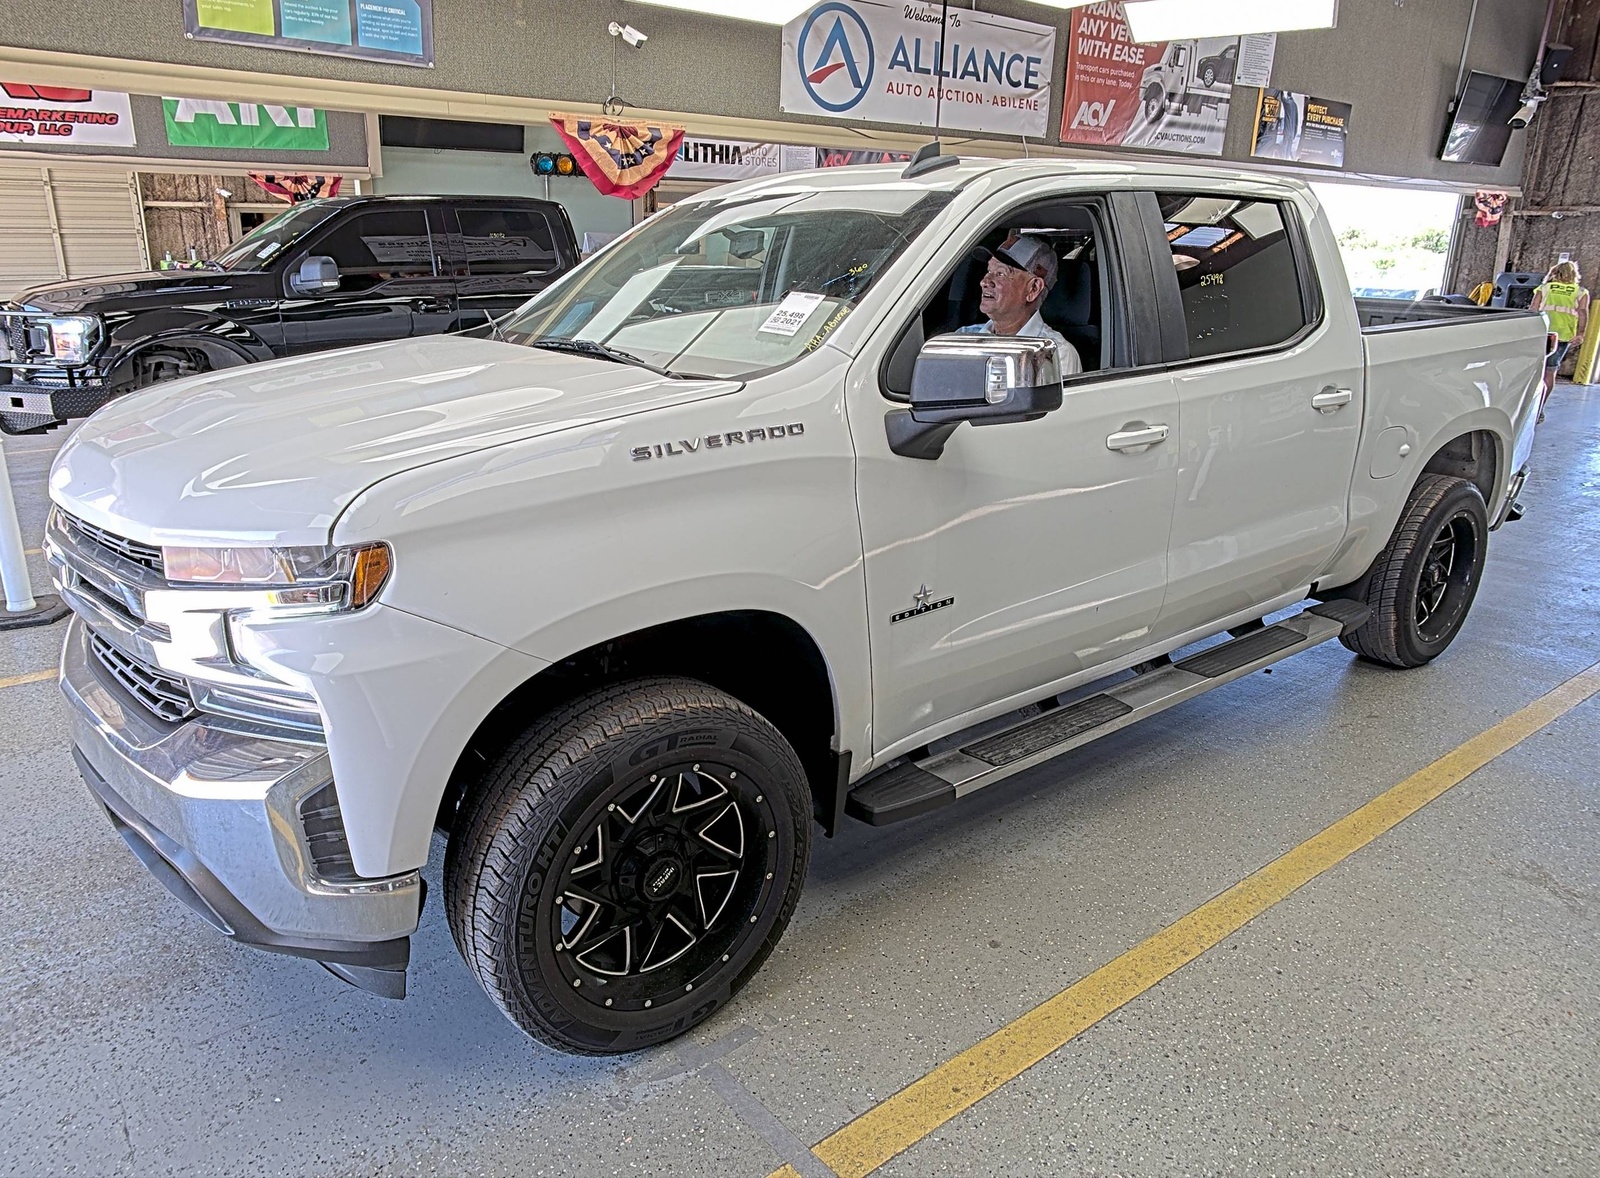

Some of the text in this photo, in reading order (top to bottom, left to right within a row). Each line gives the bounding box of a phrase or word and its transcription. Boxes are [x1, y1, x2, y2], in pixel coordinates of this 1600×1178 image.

[949, 13, 961, 28] To
[1077, 16, 1109, 38] ANY
[1078, 37, 1146, 66] WITH EASE.
[887, 35, 1042, 90] ALLIANCE
[1076, 61, 1135, 79] Transport cars purchased
[1080, 73, 1090, 83] this
[1096, 77, 1106, 86] any
[886, 81, 923, 98] AUTO
[927, 86, 983, 105] AUCTION
[1069, 99, 1117, 130] ACV
[1307, 103, 1329, 115] PROTECT
[1306, 113, 1322, 124] EVERY
[1321, 115, 1345, 127] PURCHASE
[38, 123, 73, 136] LLC
[1154, 132, 1206, 145] CVAUCTIONS.COM
[683, 141, 743, 166] LITHIA
[744, 156, 778, 168] STORES
[1200, 273, 1224, 287] 25498
[780, 317, 803, 326] 2021
[629, 421, 806, 462] SILVERADO
[895, 598, 951, 621] EDITION
[680, 734, 719, 744] RADIAL
[518, 823, 574, 1025] ADVENTURO HT
